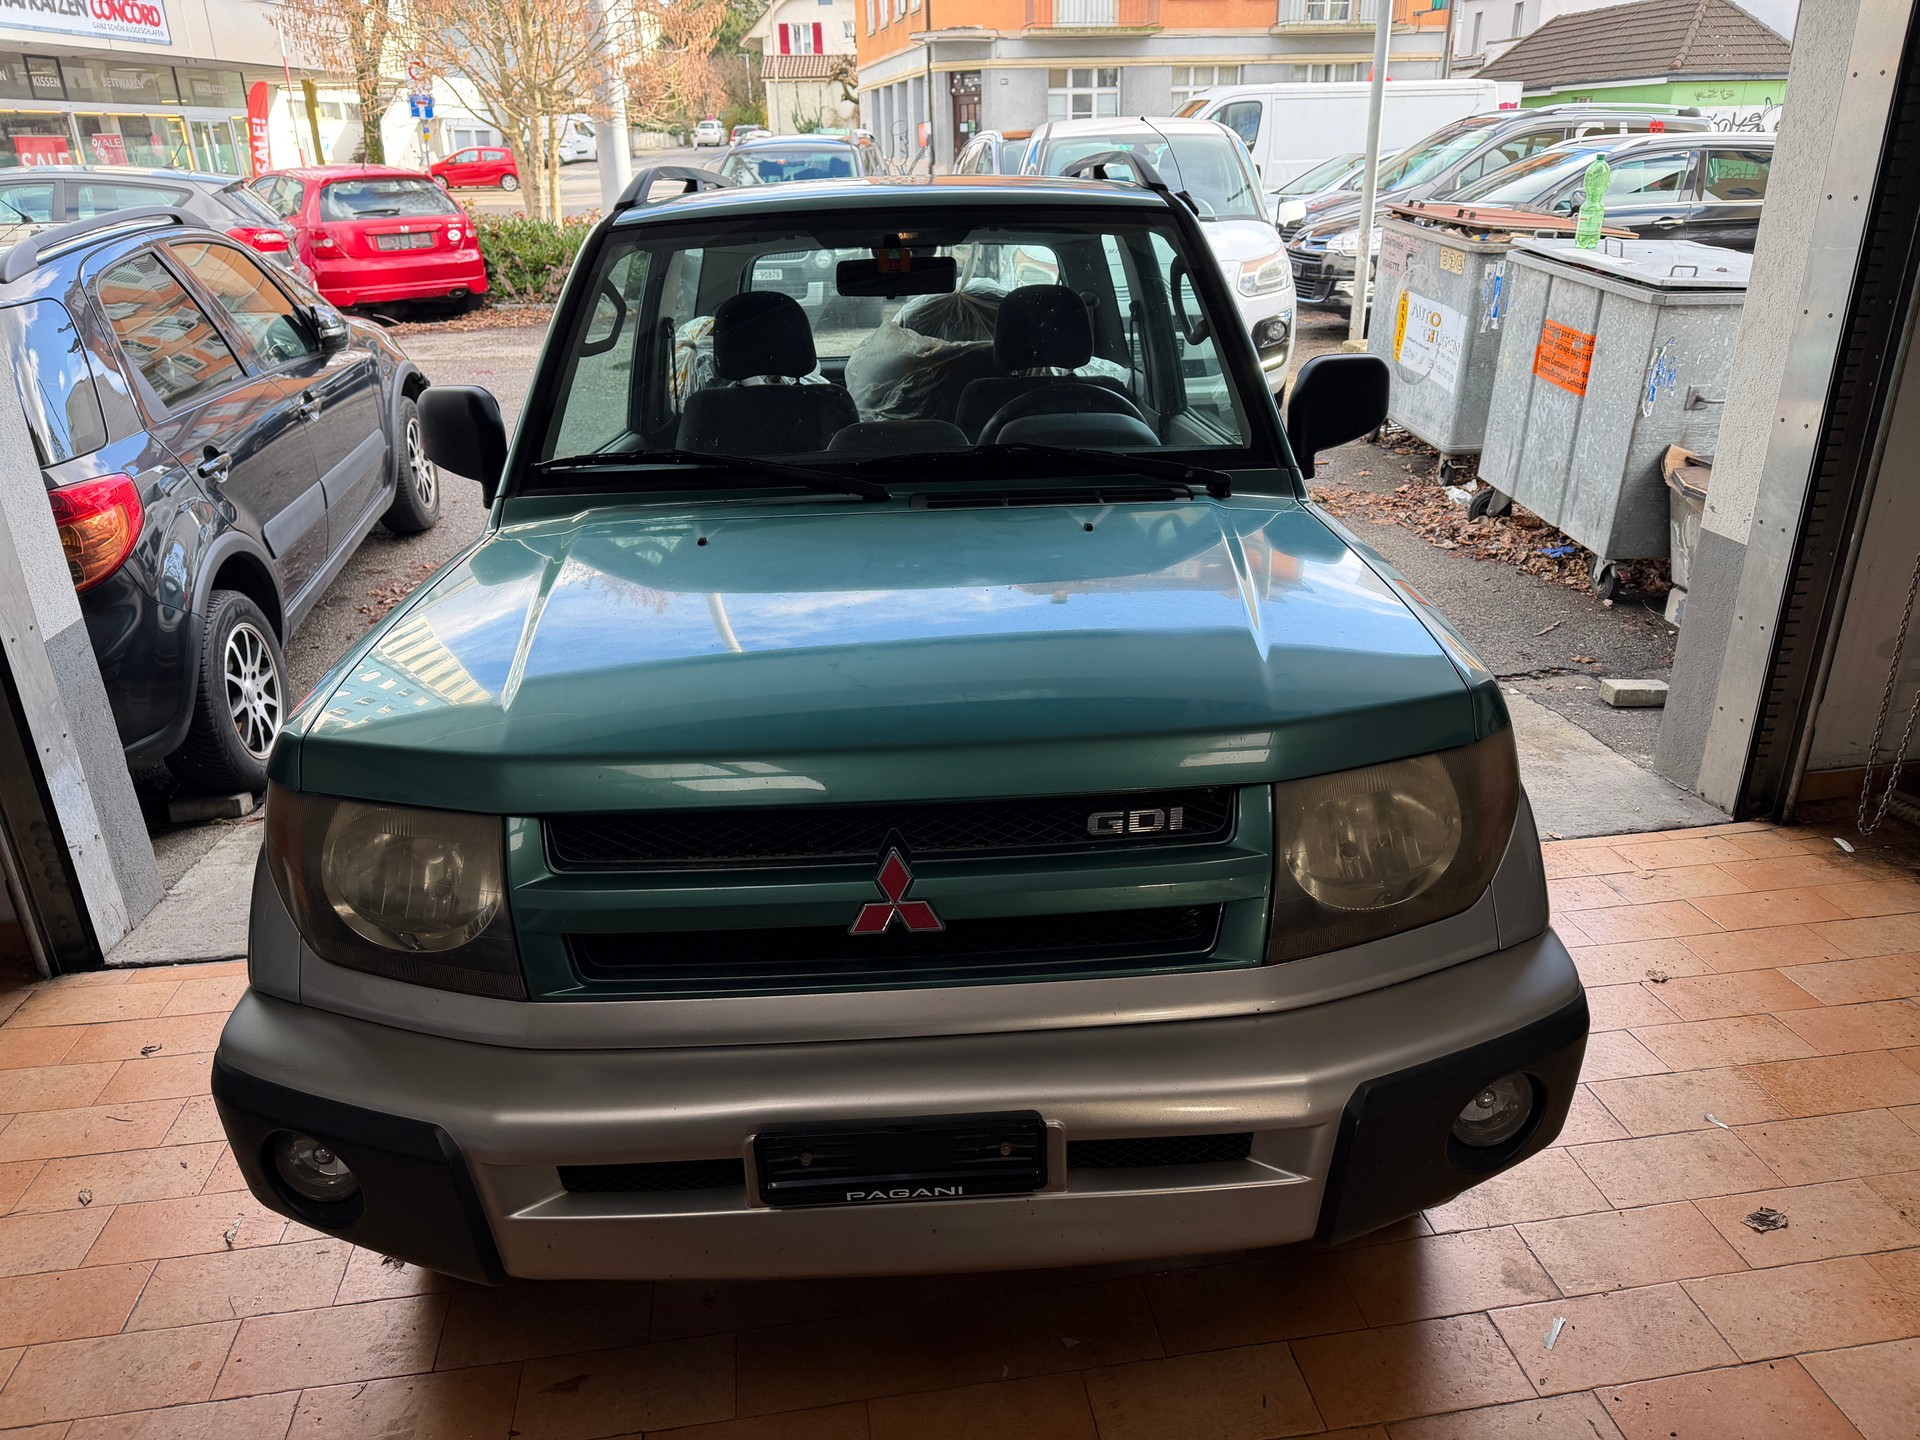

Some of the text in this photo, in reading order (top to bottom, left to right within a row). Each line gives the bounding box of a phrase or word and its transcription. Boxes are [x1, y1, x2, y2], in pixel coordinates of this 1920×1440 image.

[90, 0, 161, 27] CONCORD
[92, 21, 107, 30] GANZ
[108, 23, 125, 32] SCHÖN
[32, 76, 61, 88] KISSEN
[102, 77, 144, 90] BETTWAREN
[194, 83, 229, 95] MATRATZEN
[252, 117, 270, 174] SALE!
[1410, 303, 1442, 328] AUTO
[1087, 806, 1183, 835] GDI
[846, 1186, 963, 1201] PAGANI
